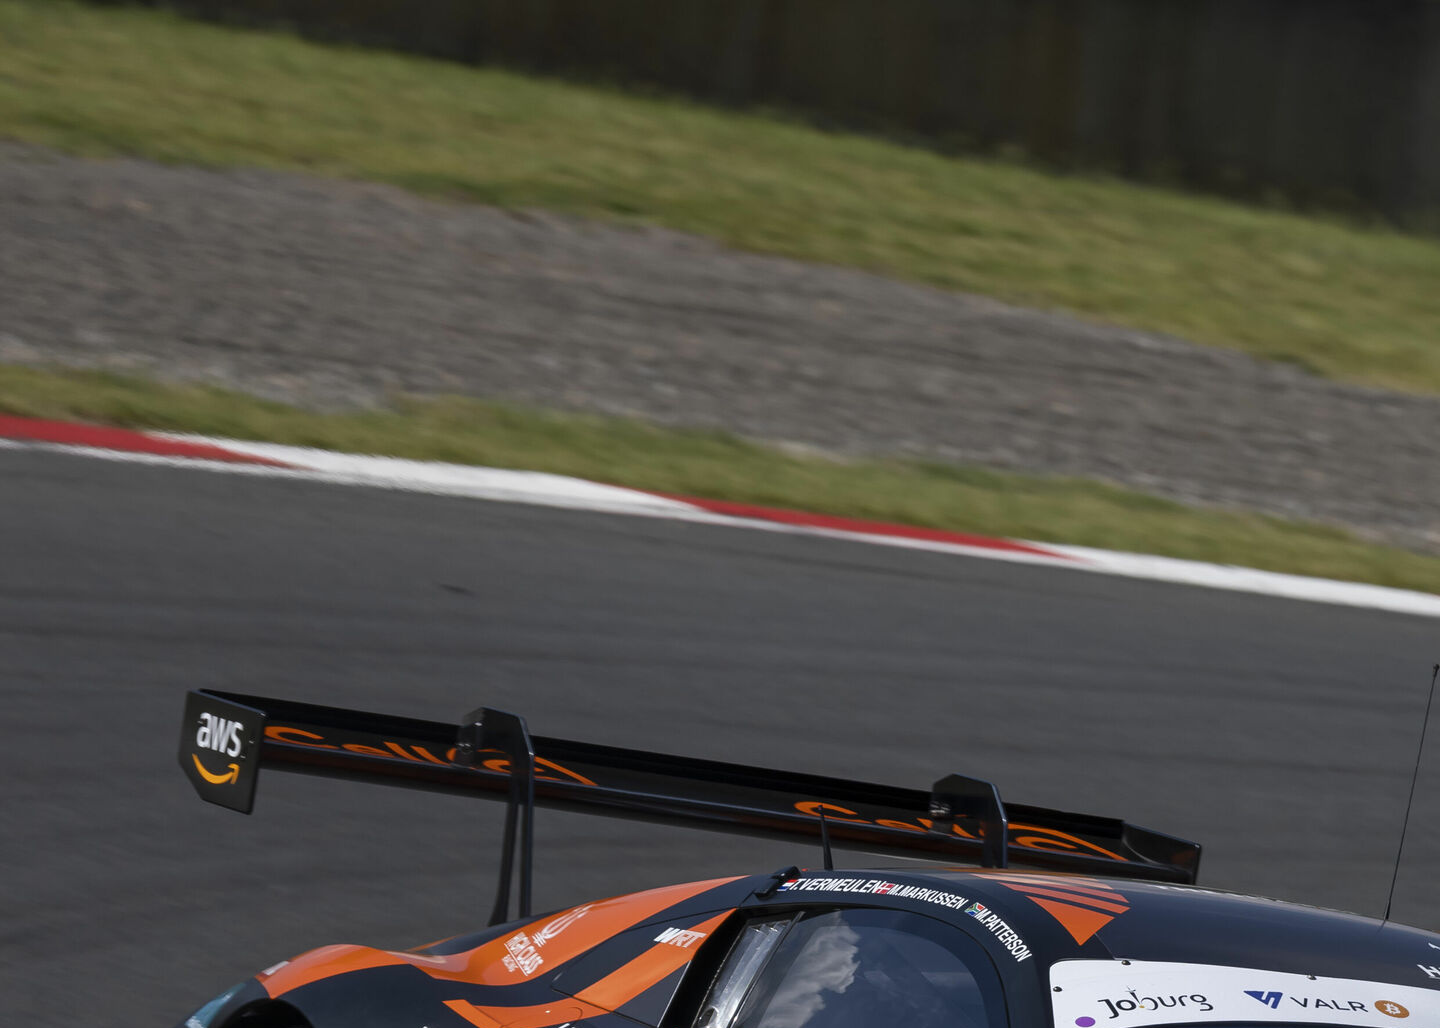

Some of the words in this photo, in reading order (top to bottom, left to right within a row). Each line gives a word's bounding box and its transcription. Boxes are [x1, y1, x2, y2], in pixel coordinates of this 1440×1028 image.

[197, 712, 244, 758] aws
[789, 878, 884, 895] T.VERMEULEN
[888, 883, 968, 910] M.MARKUSSEN
[974, 912, 1033, 963] M.PATTERSON
[1289, 996, 1369, 1013] VALR
